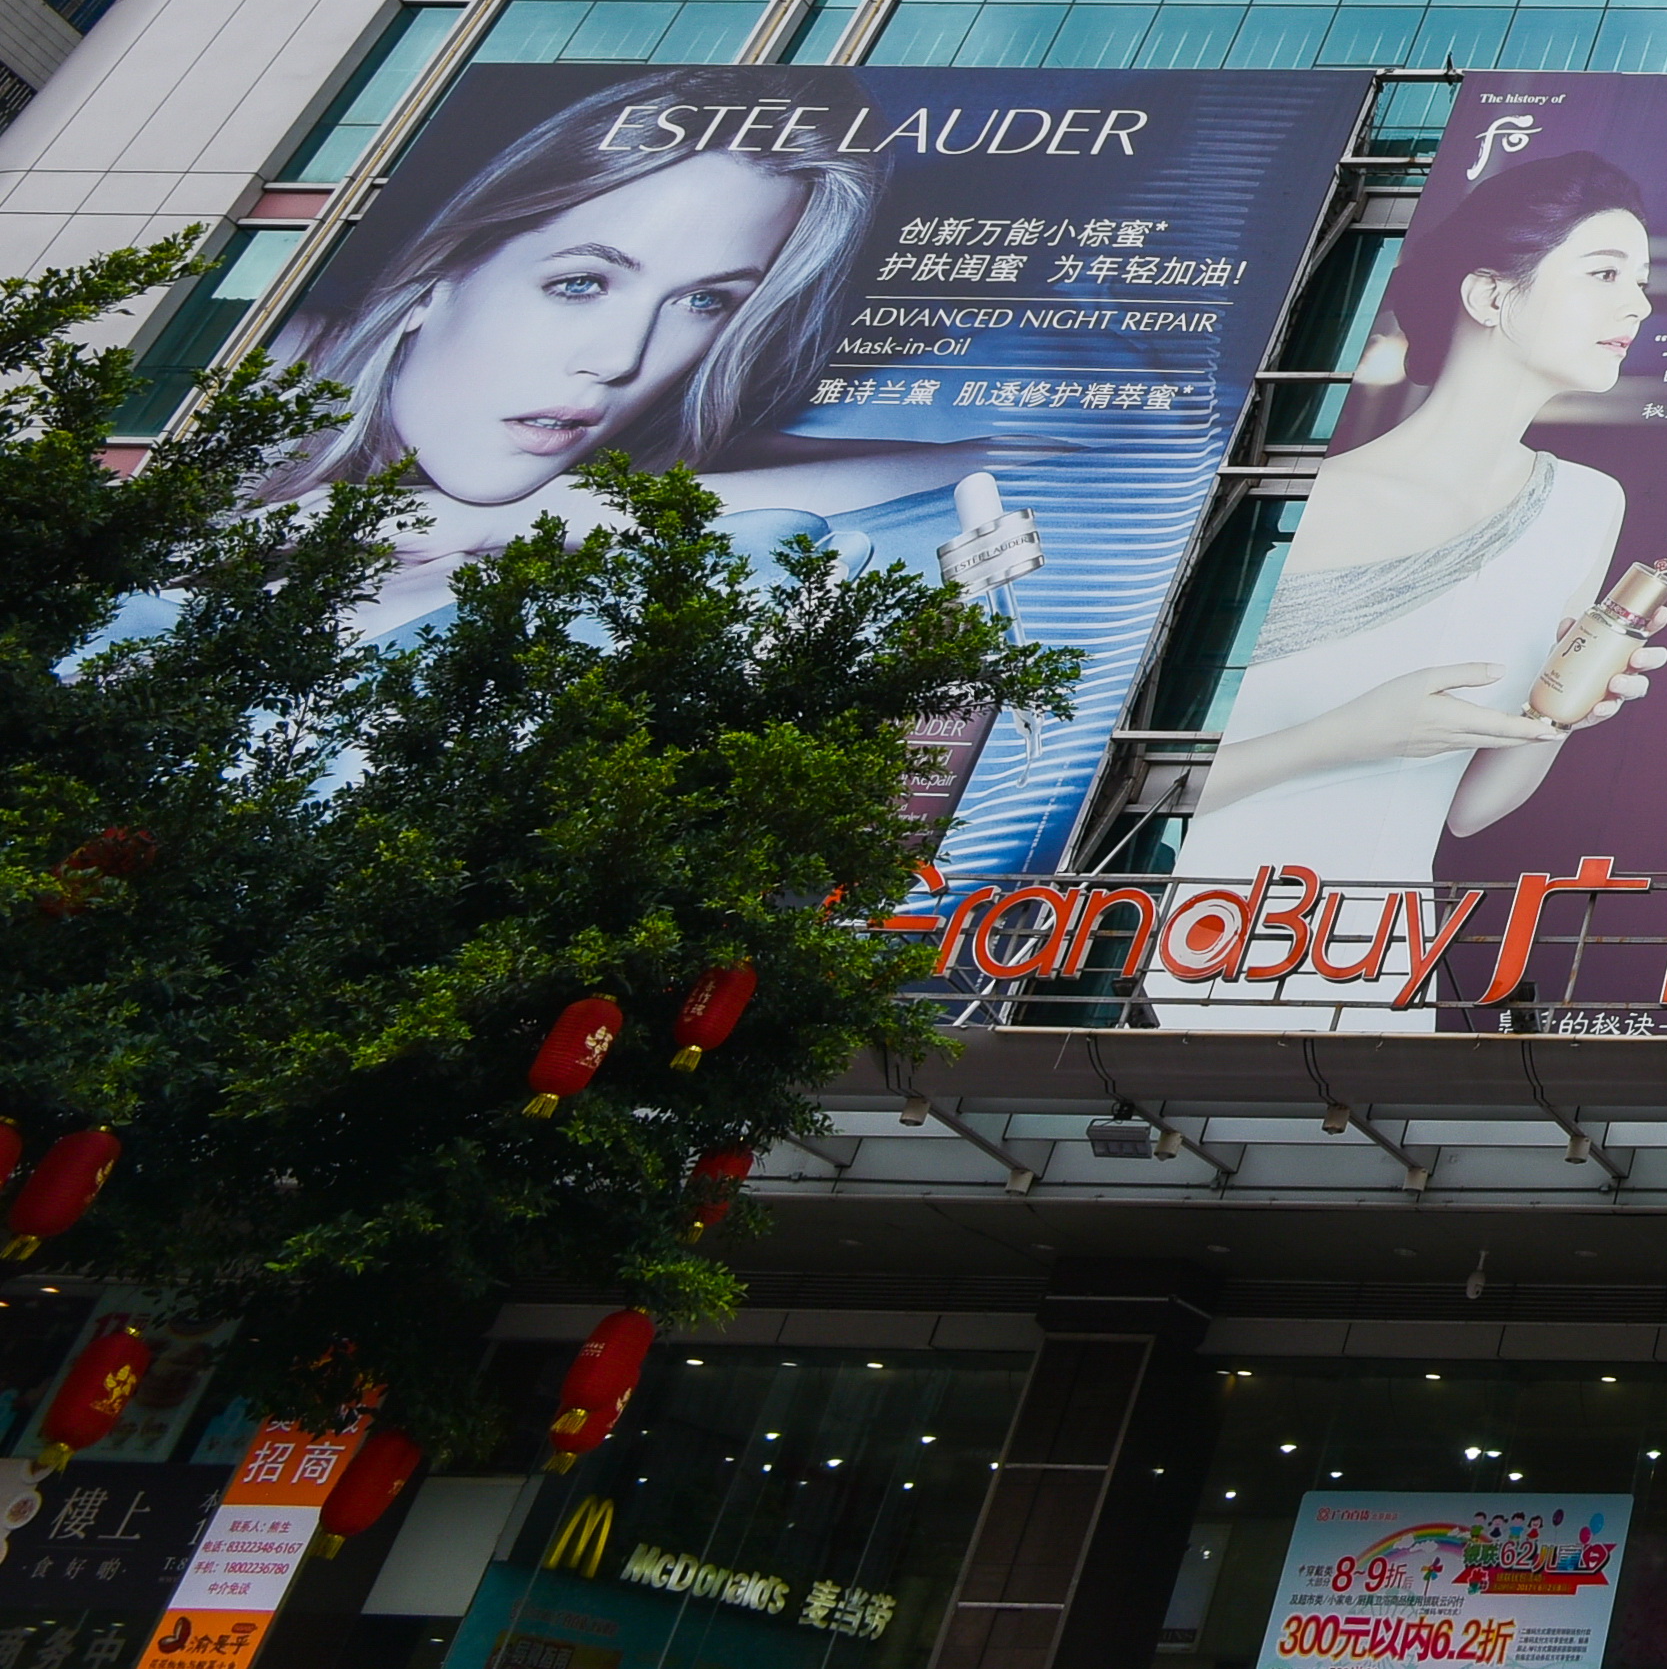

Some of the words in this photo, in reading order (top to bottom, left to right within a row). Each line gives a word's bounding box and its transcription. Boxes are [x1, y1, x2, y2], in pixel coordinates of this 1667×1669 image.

[1480, 93, 1504, 105] The
[1505, 93, 1548, 107] history
[1551, 92, 1567, 105] of
[837, 107, 1148, 156] LAUDER
[876, 252, 1029, 283] 护肤闺蜜
[1046, 254, 1248, 287] 为年轻加油!
[851, 307, 1014, 329] ADVANCED
[1019, 308, 1117, 331] NIGHT
[1120, 311, 1219, 333] REPAIR
[836, 336, 972, 357] Mask-in-Oil
[809, 378, 940, 406] 雅诗兰黛
[909, 719, 967, 737] UDER
[242, 1440, 346, 1485] 招商
[48, 1486, 151, 1540] 樓上
[619, 1541, 792, 1616] McDonald's
[797, 1578, 899, 1642] 麦当劳
[1279, 1614, 1516, 1666] 300元以内6.2折
